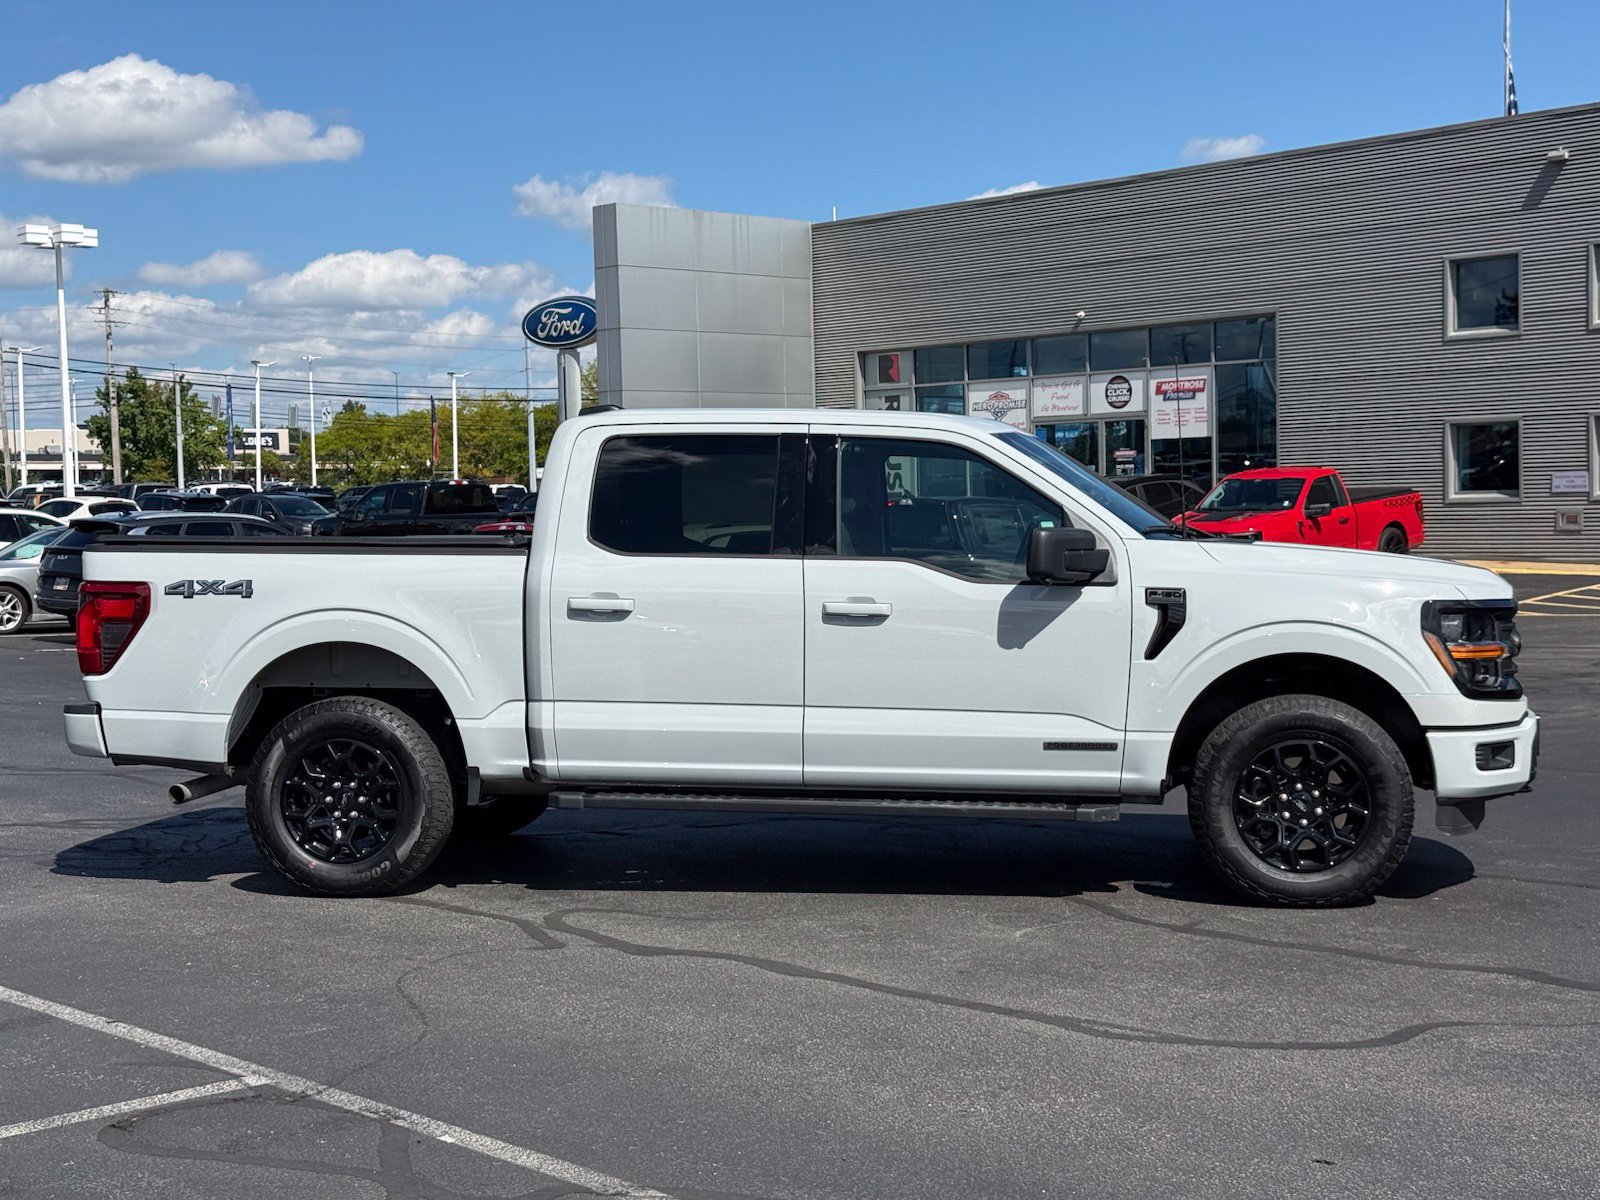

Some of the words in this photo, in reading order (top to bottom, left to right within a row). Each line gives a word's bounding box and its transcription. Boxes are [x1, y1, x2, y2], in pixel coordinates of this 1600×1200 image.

[537, 307, 585, 339] Ford
[1160, 380, 1205, 391] MONTROSE
[972, 402, 993, 411] HERO
[993, 400, 1026, 410] PROMISE
